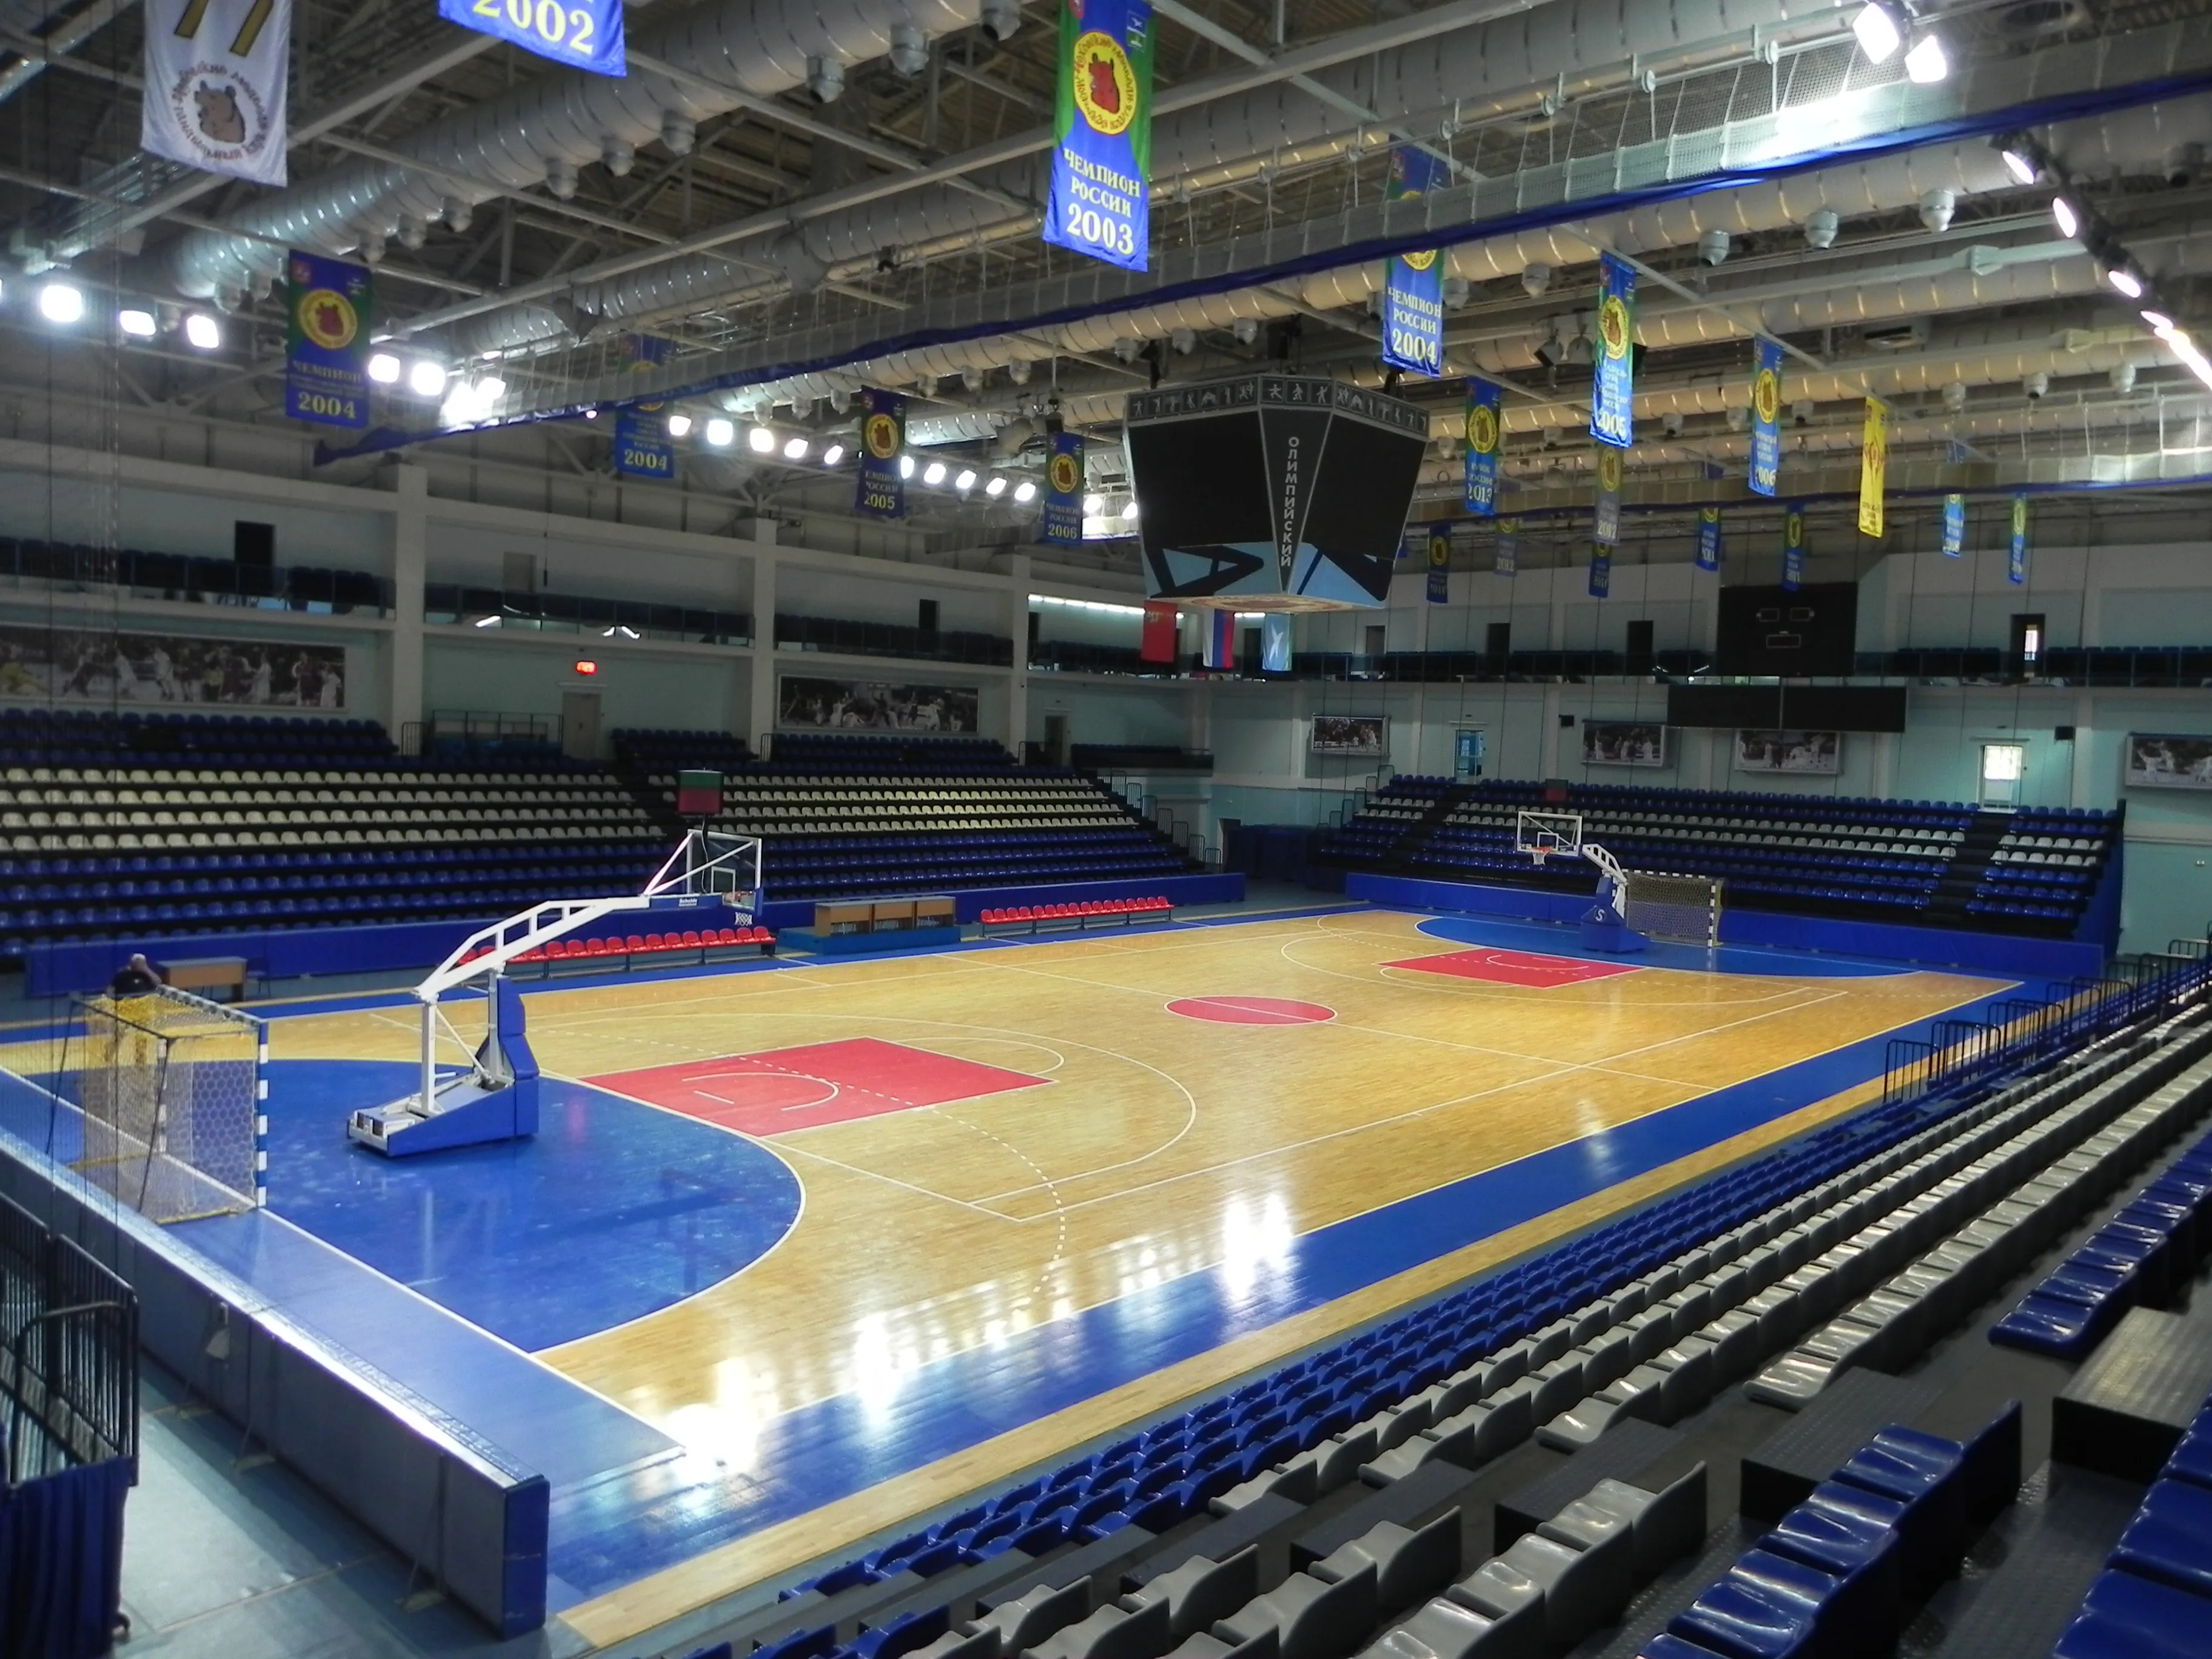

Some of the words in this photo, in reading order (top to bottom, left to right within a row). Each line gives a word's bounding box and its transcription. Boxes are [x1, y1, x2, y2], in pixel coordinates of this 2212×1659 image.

[1064, 147, 1141, 198] ЧЕМПИОН
[1070, 176, 1131, 218] РОССИИ
[1067, 203, 1134, 255] 2003
[1387, 286, 1442, 318] ЧЕМПИОН
[1393, 307, 1436, 335] РОССИИ
[1392, 328, 1436, 365] 2004
[298, 391, 357, 420] 2004
[624, 448, 668, 471] 2004
[864, 492, 896, 510] 2005
[1281, 437, 1299, 567] ОЛИМПИЙСКИЙ
[1047, 523, 1078, 540] 2006
[1595, 909, 1605, 922] S
